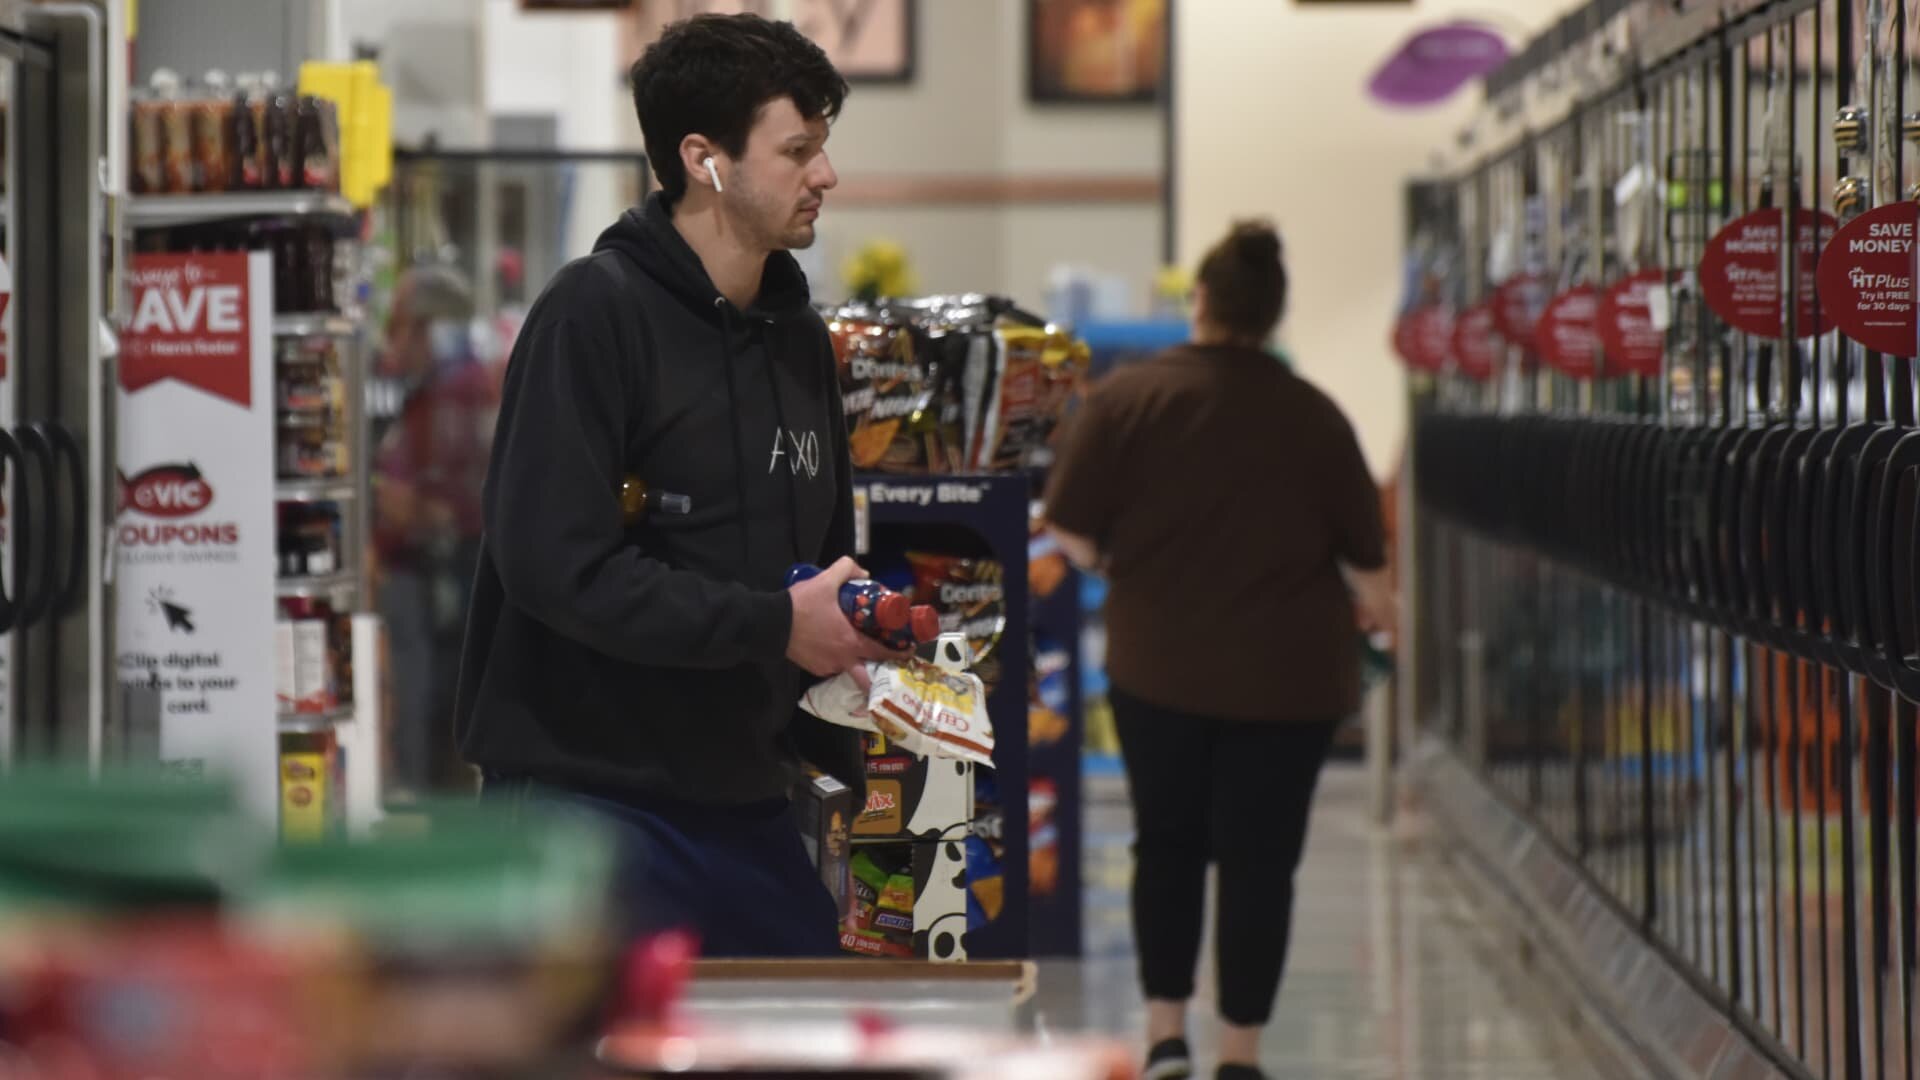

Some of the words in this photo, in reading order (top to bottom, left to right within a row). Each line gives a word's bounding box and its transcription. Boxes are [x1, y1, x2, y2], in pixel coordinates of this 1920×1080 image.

[1869, 223, 1913, 237] SAVE
[1849, 240, 1913, 253] MONEY
[1860, 291, 1876, 301] Try
[1877, 291, 1884, 299] it
[1886, 291, 1910, 299] FREE
[122, 284, 242, 335] AVE
[1857, 302, 1871, 310] for
[1872, 302, 1886, 310] 30
[1887, 302, 1910, 312] days
[870, 483, 934, 506] Every
[120, 524, 238, 546] OUPONS
[199, 677, 237, 694] your
[863, 791, 895, 812] wix
[840, 934, 857, 946] 40
